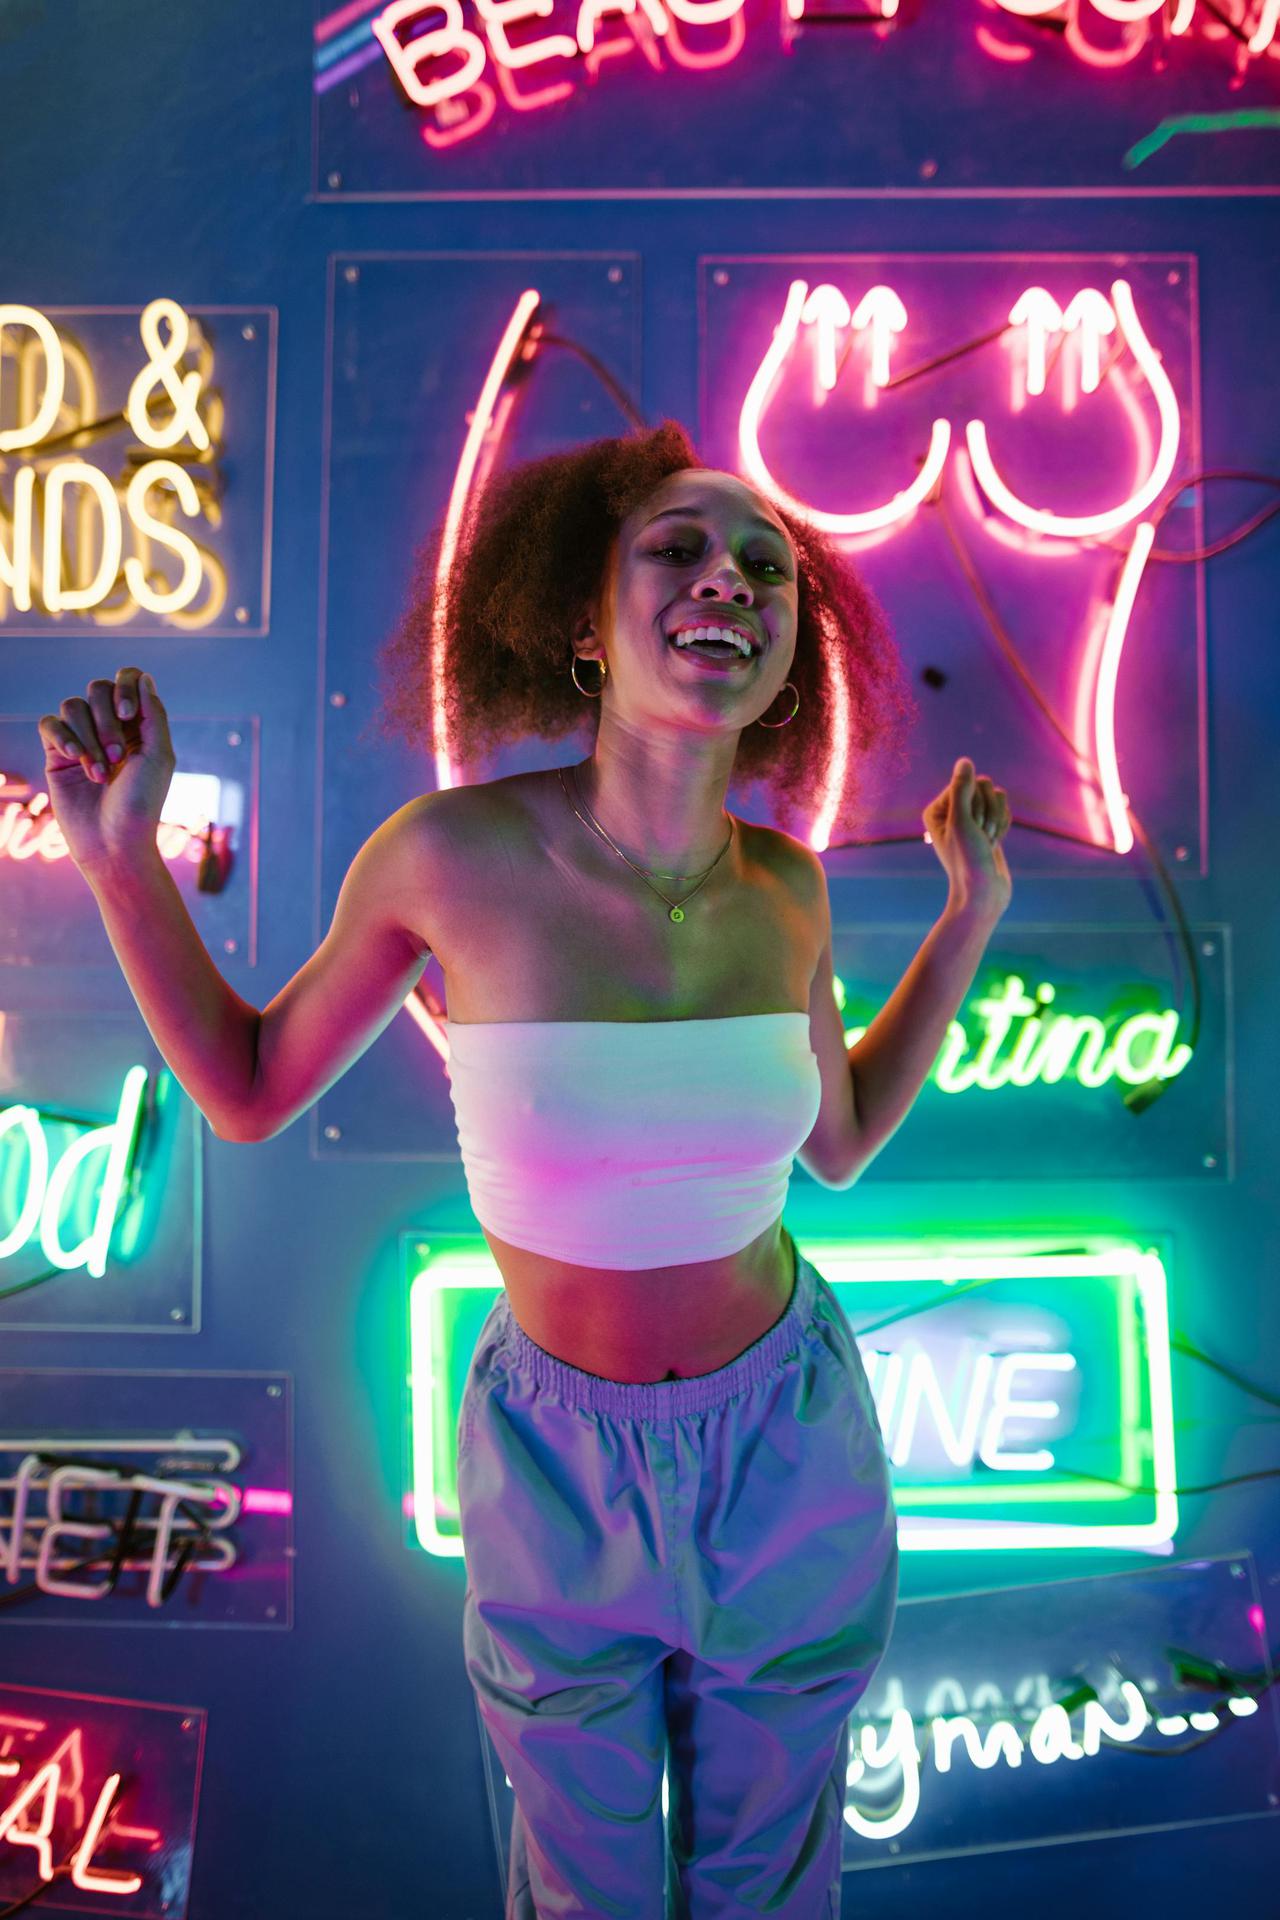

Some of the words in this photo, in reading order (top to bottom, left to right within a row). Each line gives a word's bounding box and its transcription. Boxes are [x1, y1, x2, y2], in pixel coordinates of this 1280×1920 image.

[128, 298, 210, 450] &
[861, 1350, 1077, 1471] INE
[0, 1761, 142, 1894] AL
